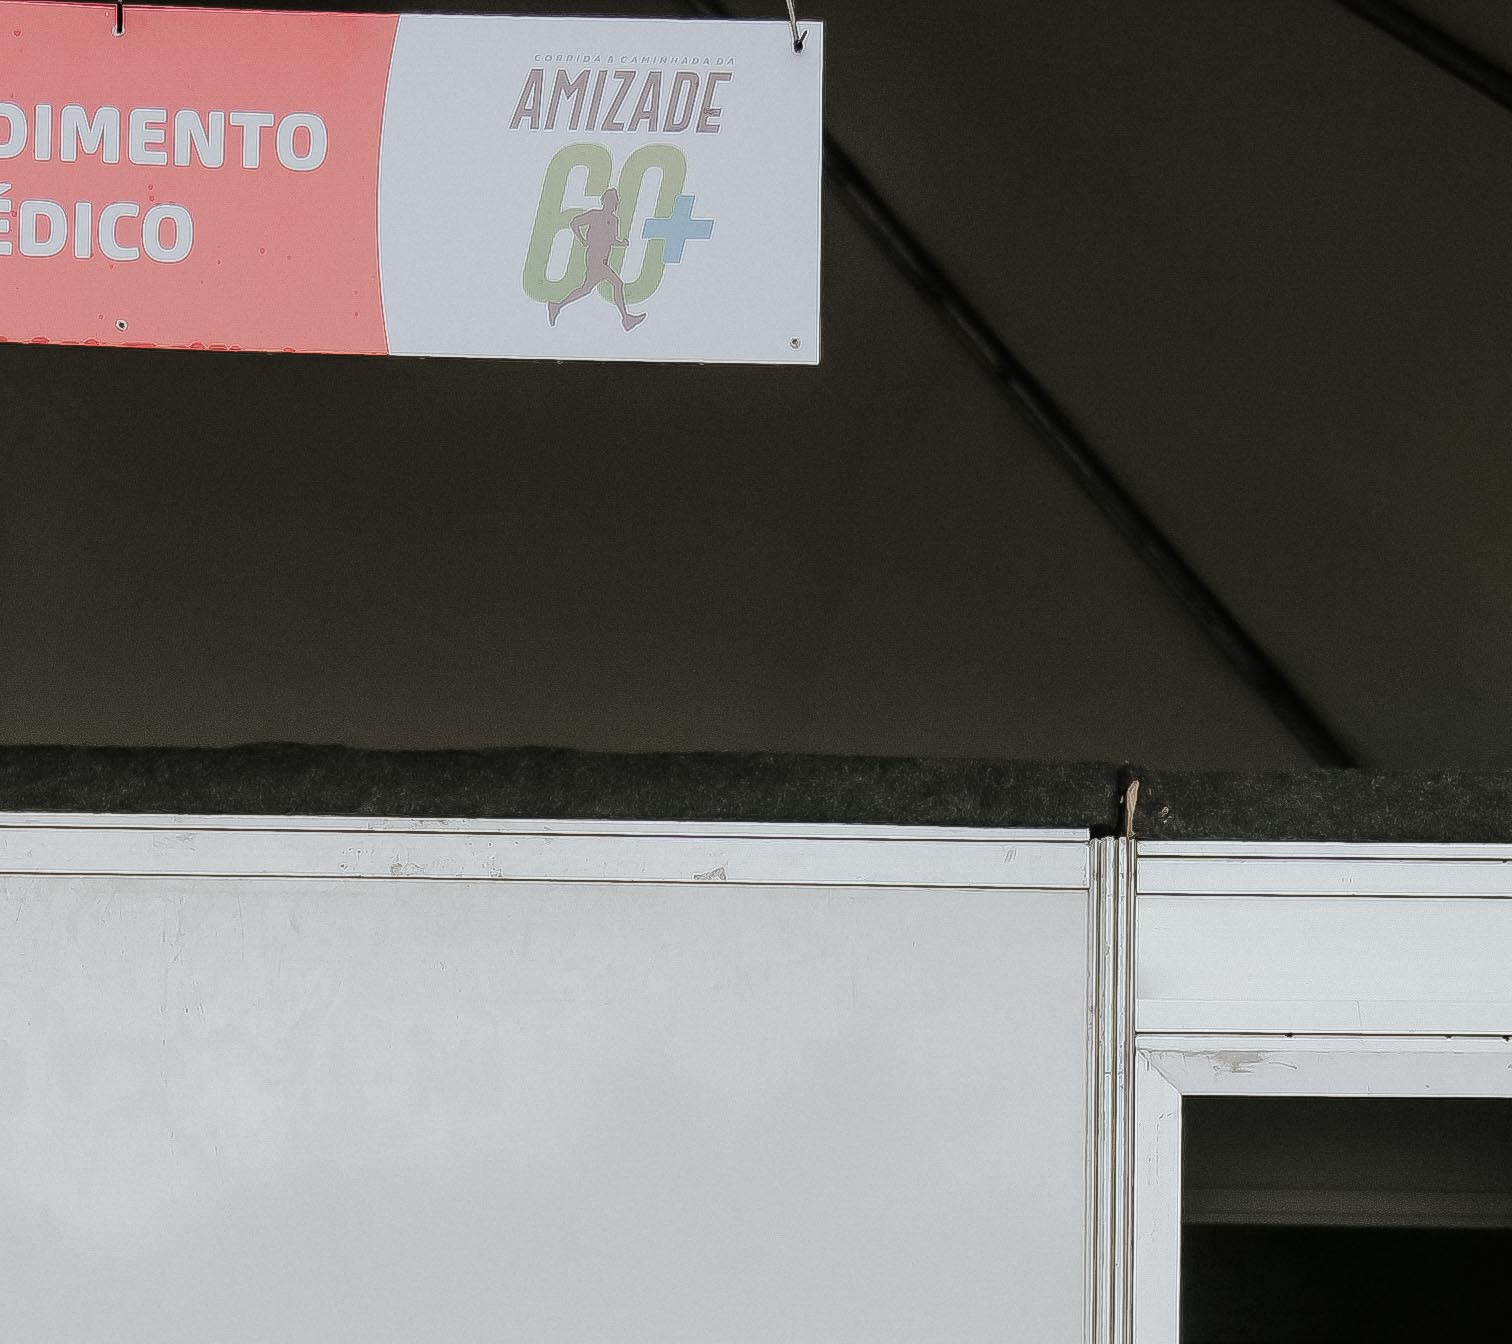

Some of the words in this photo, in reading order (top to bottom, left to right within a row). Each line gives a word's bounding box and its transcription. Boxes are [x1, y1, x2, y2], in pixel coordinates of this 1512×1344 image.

[533, 54, 602, 63] CORRIDA
[619, 55, 711, 66] CAMINHADA
[715, 57, 735, 66] DA
[509, 68, 733, 134] AMIZADE
[522, 142, 715, 304] 60+
